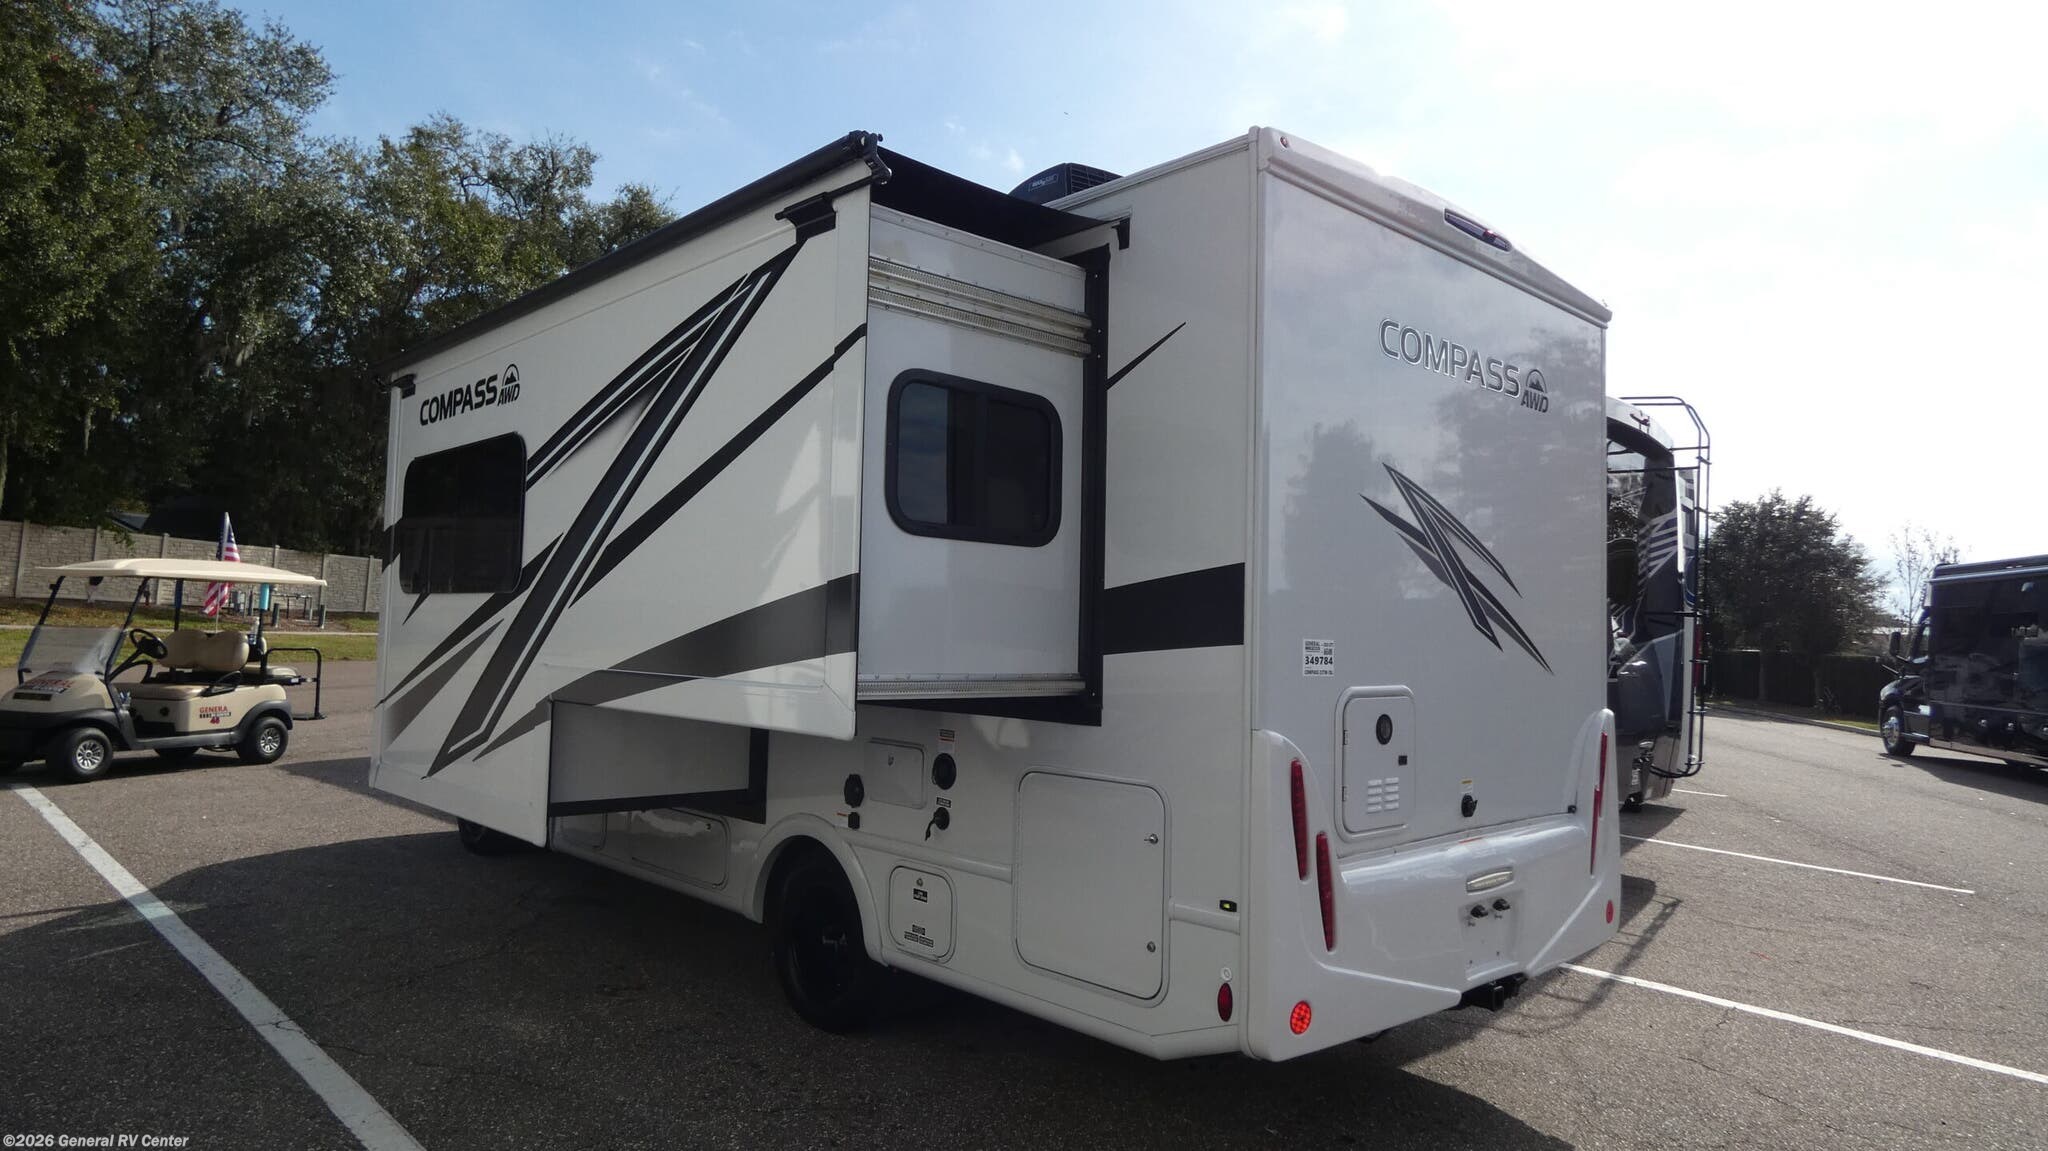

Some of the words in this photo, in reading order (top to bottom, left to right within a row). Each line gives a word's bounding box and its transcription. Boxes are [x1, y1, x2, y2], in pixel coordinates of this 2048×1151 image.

[1380, 319, 1521, 399] COMPASS
[1520, 389, 1549, 413] AWD
[420, 374, 498, 426] COMPASS
[497, 383, 521, 406] AWD
[1305, 656, 1333, 665] 349784
